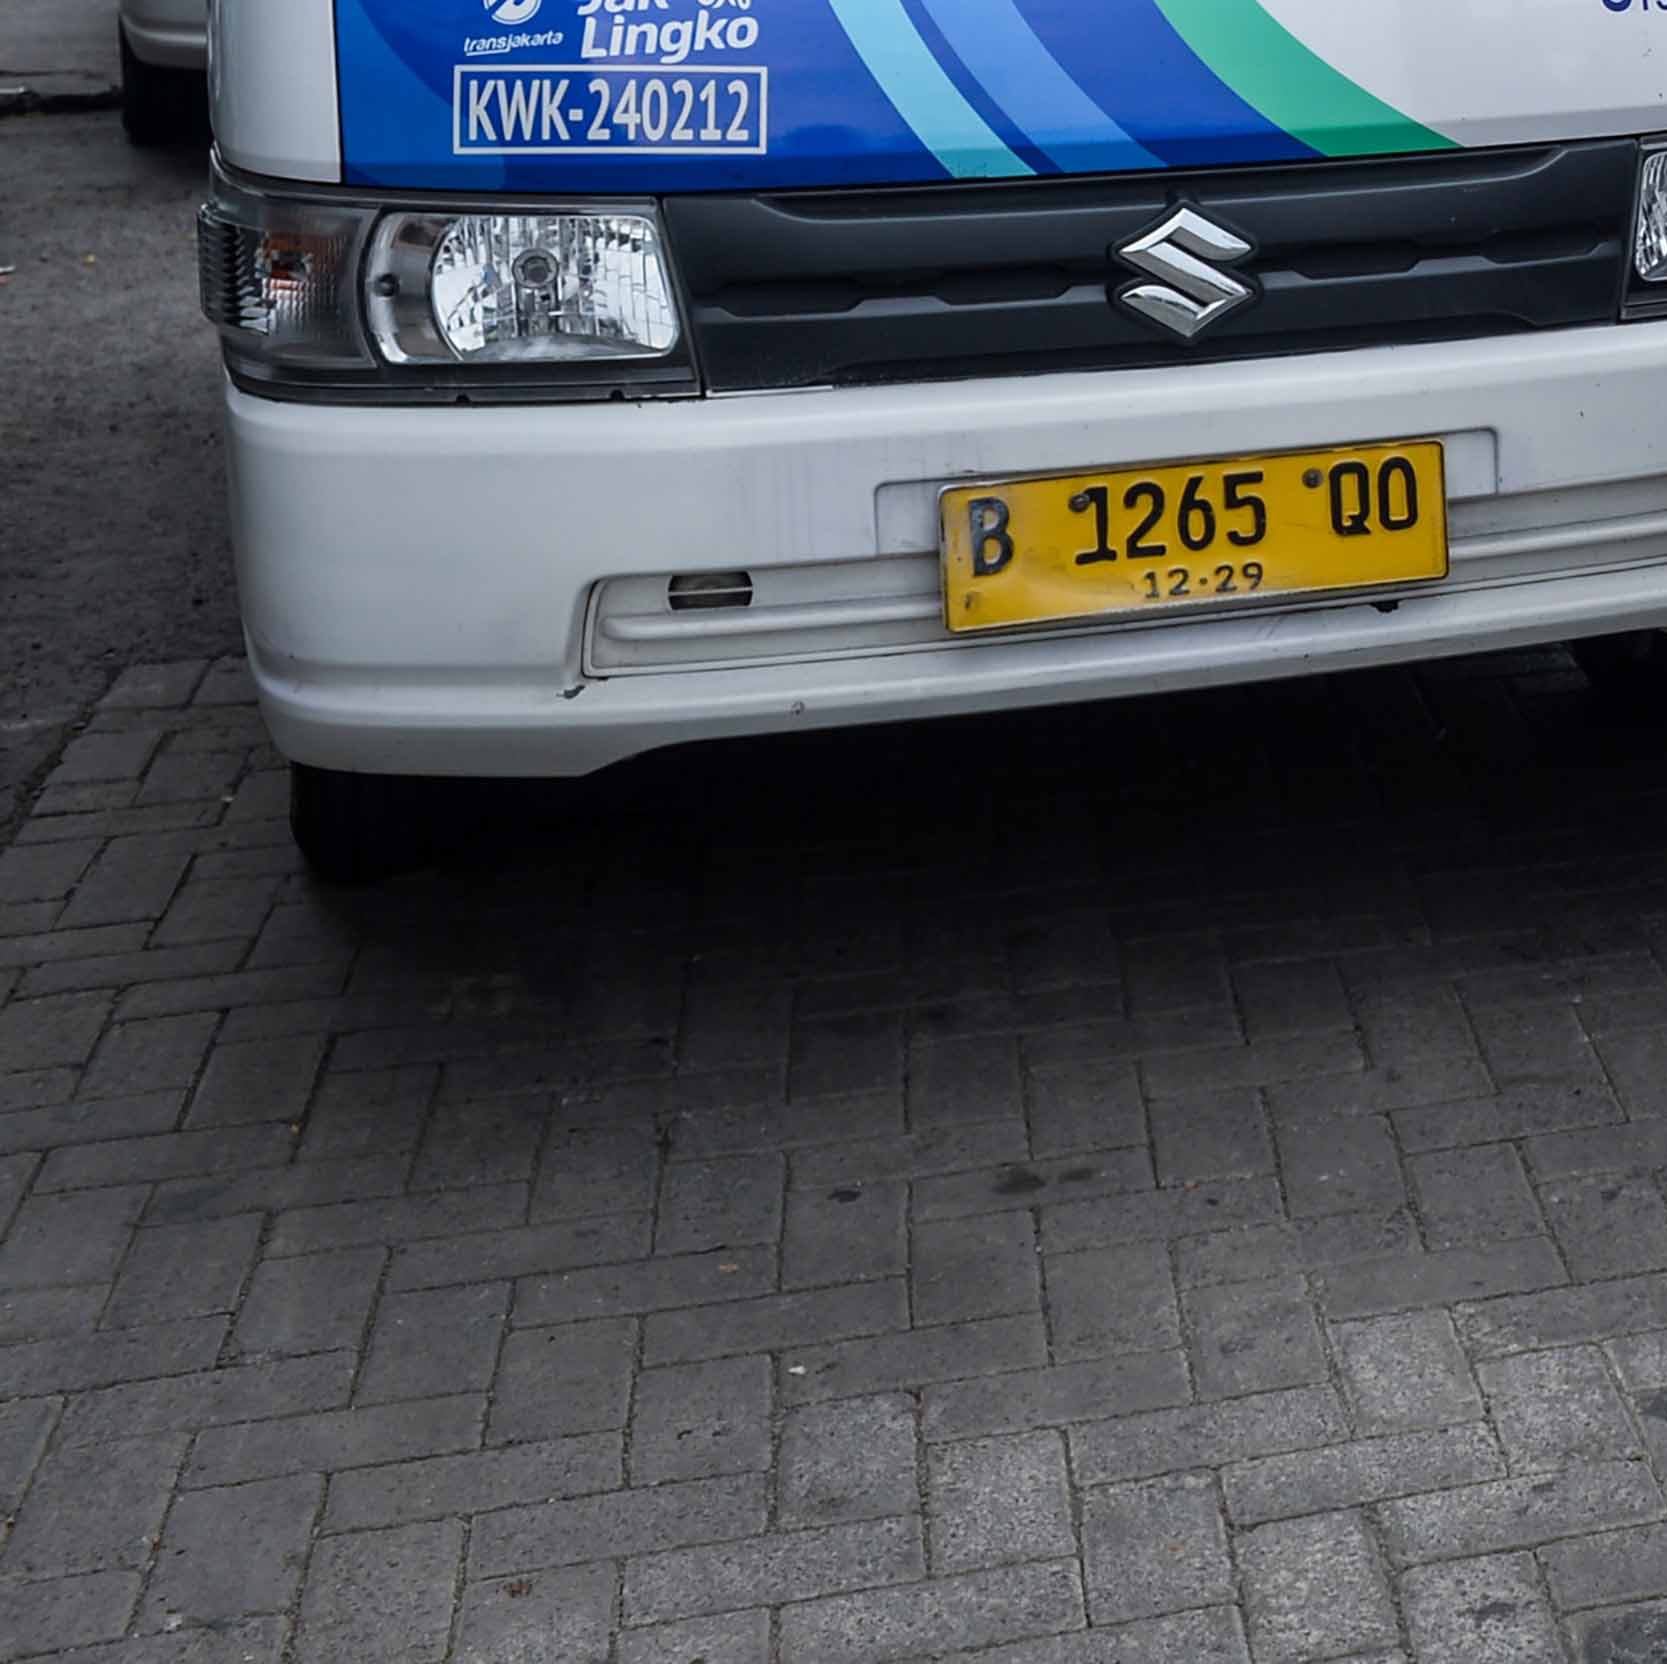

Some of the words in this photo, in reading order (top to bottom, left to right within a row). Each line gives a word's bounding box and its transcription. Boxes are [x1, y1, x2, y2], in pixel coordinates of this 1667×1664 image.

[463, 30, 565, 57] transjakarta
[581, 9, 760, 65] Lingko
[467, 78, 750, 143] KWK-240212
[967, 497, 1016, 579] B
[1073, 470, 1269, 566] 1265
